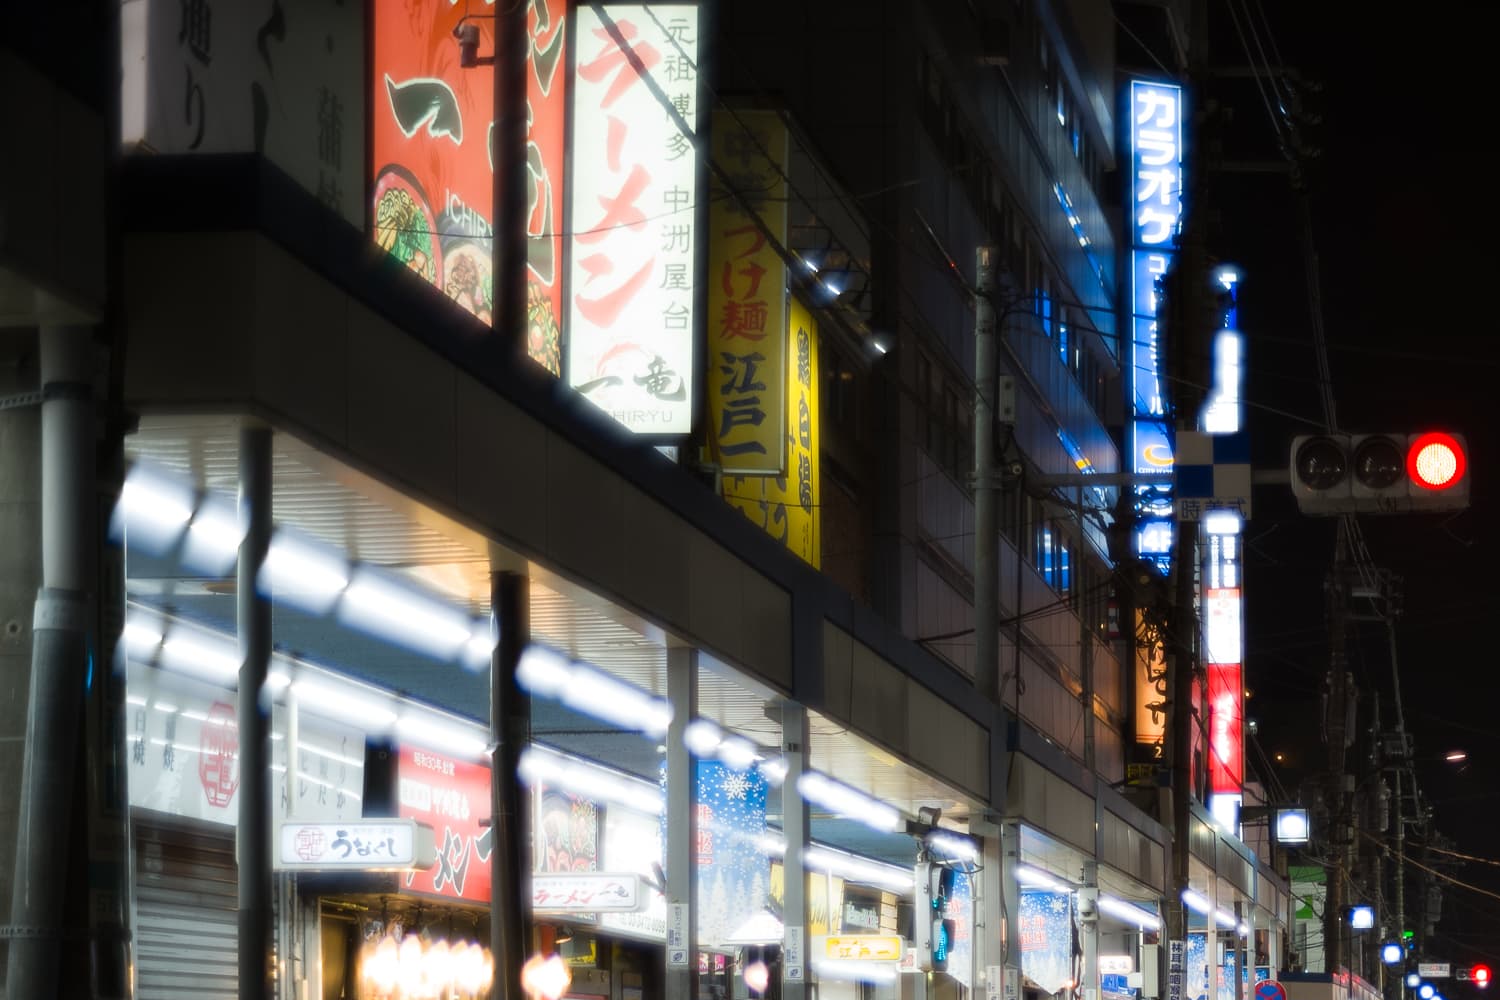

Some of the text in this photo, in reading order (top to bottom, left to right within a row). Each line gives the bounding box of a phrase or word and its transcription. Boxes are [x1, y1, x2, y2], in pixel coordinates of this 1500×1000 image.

[664, 18, 695, 162] 元祖博多
[575, 18, 661, 329] ラーメン
[1137, 90, 1176, 245] カラオケ
[660, 185, 692, 331] 中洲屋台
[722, 222, 768, 341] つけ麺
[573, 355, 686, 402] 一竜
[719, 352, 767, 456] 江戸一
[331, 829, 398, 858] うなくし
[534, 888, 595, 905] ラーメン
